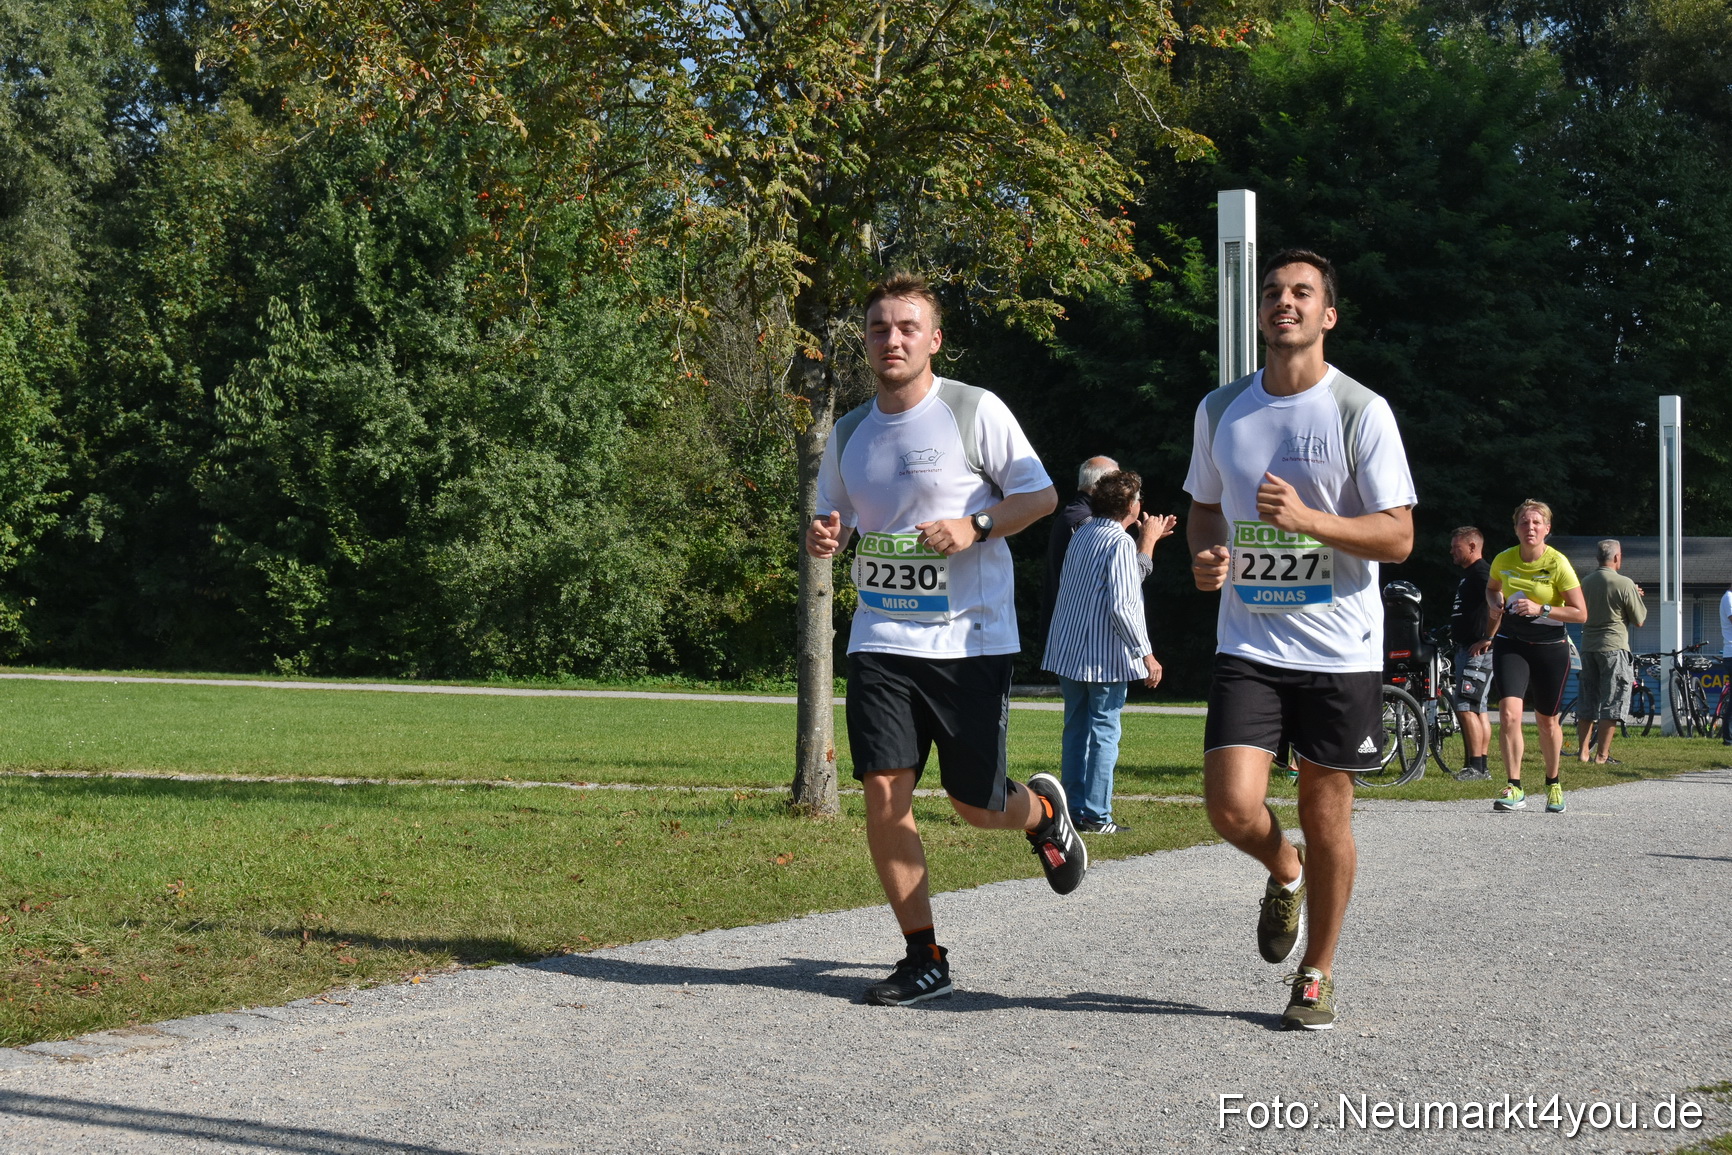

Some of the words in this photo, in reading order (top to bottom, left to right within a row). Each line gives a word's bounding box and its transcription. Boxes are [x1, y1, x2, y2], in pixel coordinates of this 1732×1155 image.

[866, 562, 938, 590] 2230
[1241, 553, 1319, 580] 2227
[882, 597, 918, 609] MIRO
[1253, 590, 1306, 602] JONAS
